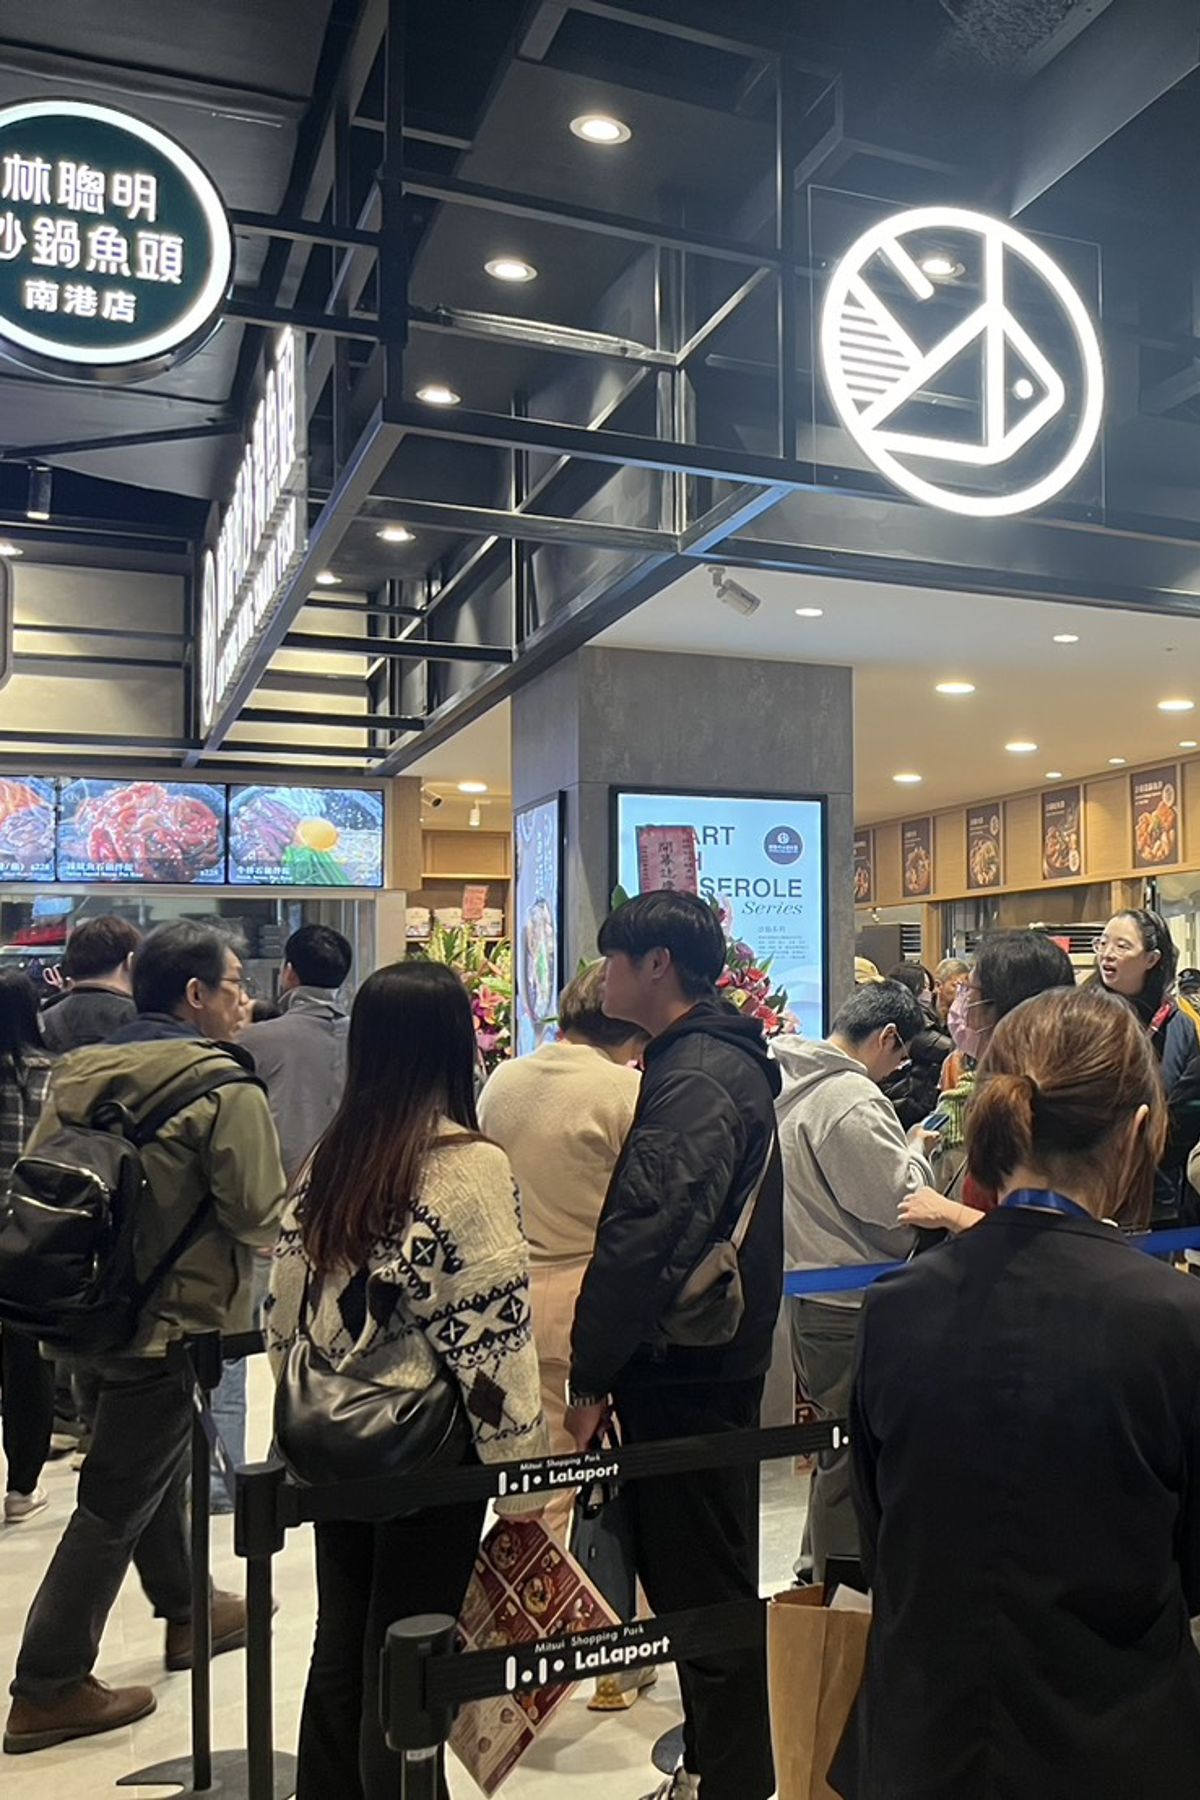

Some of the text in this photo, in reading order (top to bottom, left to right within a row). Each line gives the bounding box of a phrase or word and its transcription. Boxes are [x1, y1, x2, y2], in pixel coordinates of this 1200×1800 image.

[2, 153, 158, 222] 林聰明
[24, 280, 138, 324] 南港店
[699, 877, 802, 898] SEROLE
[741, 900, 803, 915] Series
[549, 1463, 619, 1484] LaLaport
[534, 1624, 645, 1653] Mitsui Shopping Park
[574, 1635, 670, 1670] LaLaport
